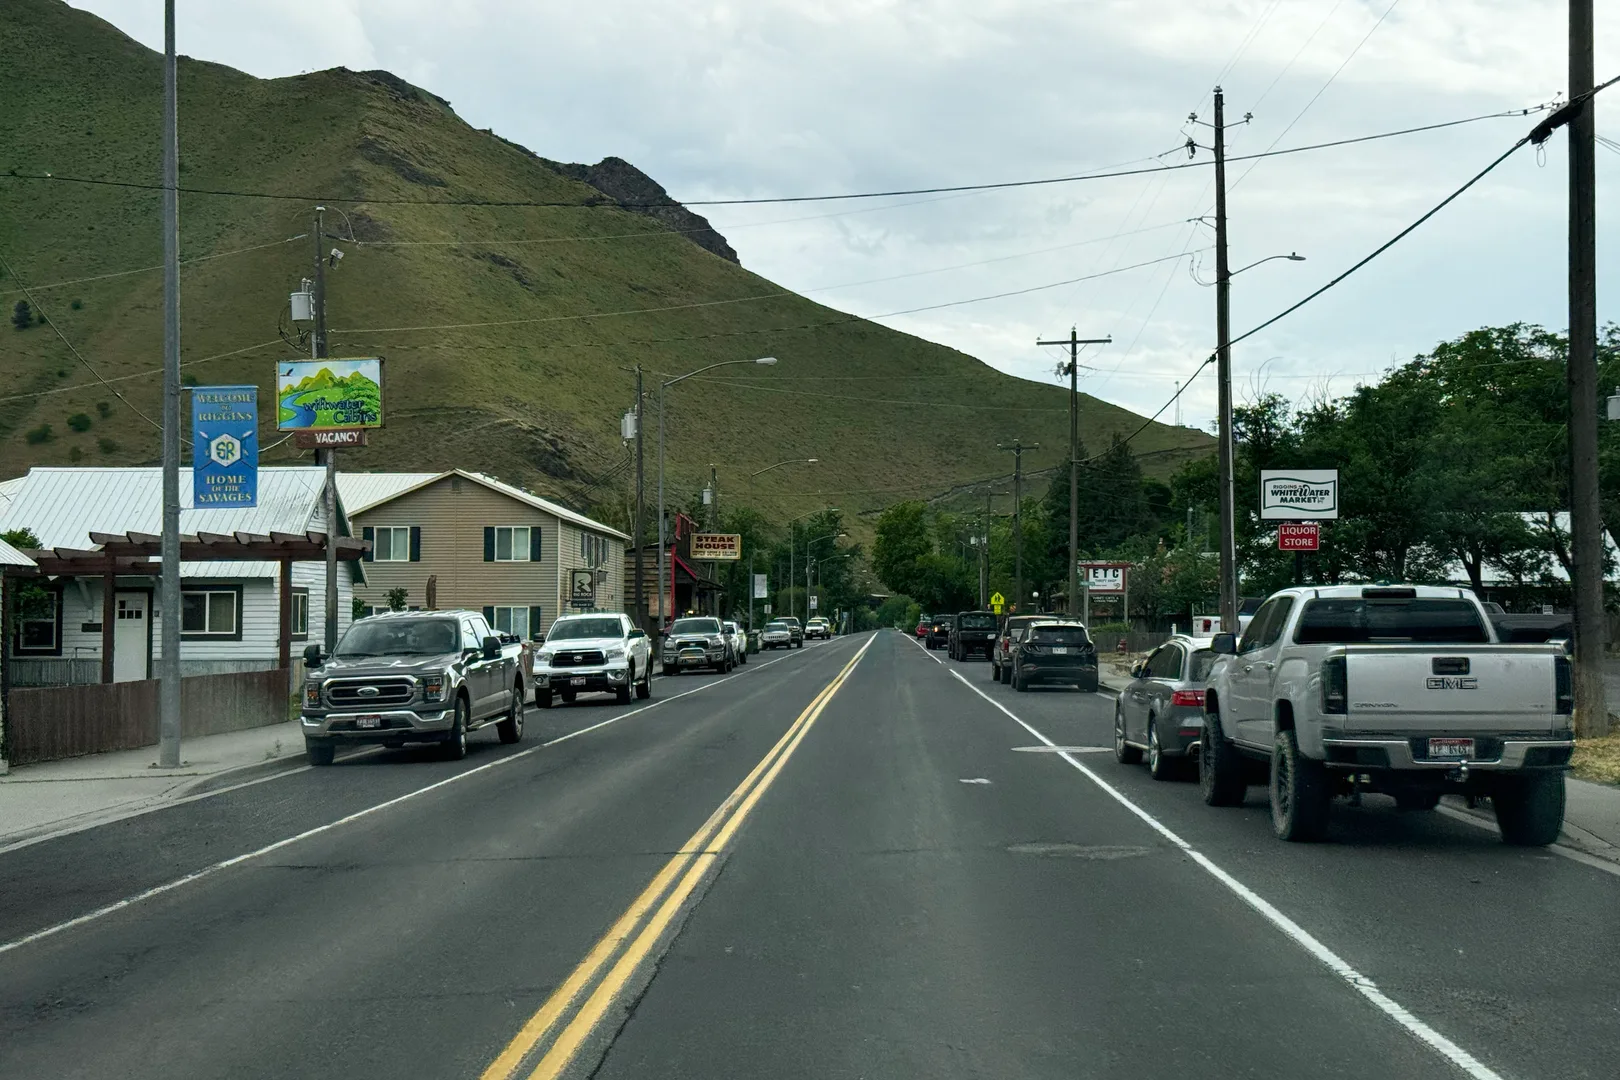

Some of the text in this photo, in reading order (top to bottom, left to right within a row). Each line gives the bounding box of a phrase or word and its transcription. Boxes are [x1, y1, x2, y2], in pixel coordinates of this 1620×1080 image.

[197, 393, 253, 403] WELCOME
[199, 411, 253, 421] RIGGINS
[333, 410, 378, 424] Cabins
[315, 431, 360, 444] VACANCY
[206, 475, 246, 485] HOME
[199, 493, 252, 503] SAVAGES
[1281, 527, 1316, 535] LIQUOR
[1284, 538, 1314, 546] STORE
[1426, 677, 1478, 690] GMC
